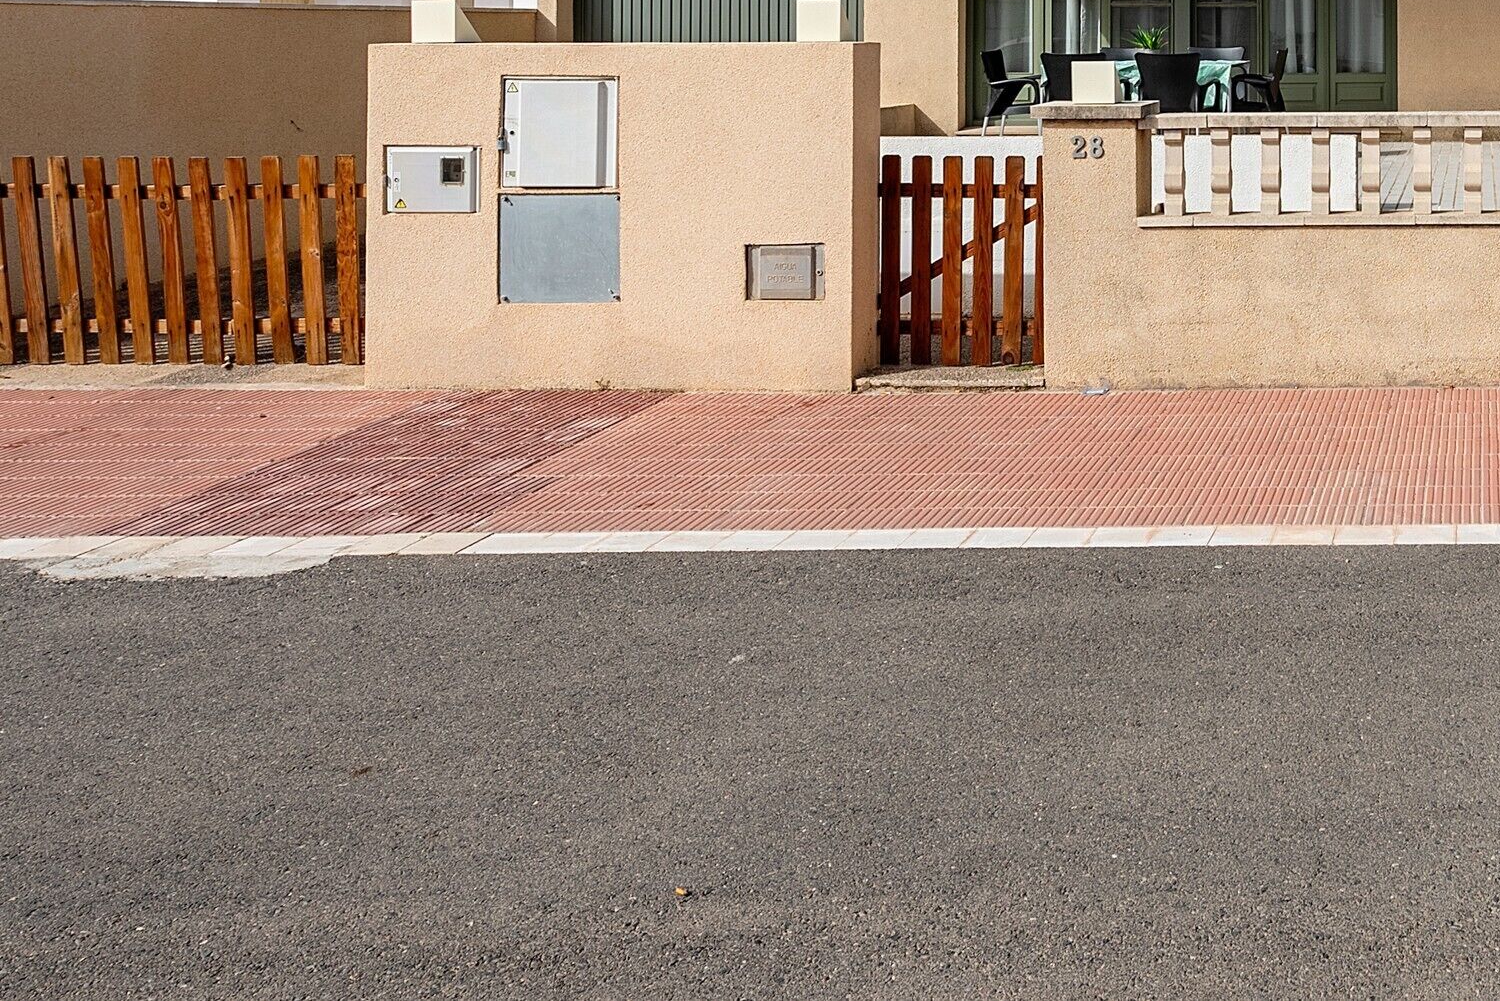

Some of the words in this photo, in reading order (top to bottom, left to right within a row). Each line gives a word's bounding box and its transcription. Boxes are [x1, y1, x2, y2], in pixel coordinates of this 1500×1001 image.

[1071, 135, 1105, 160] 28
[774, 262, 797, 271] AIGUA
[767, 275, 804, 284] POTABLE
